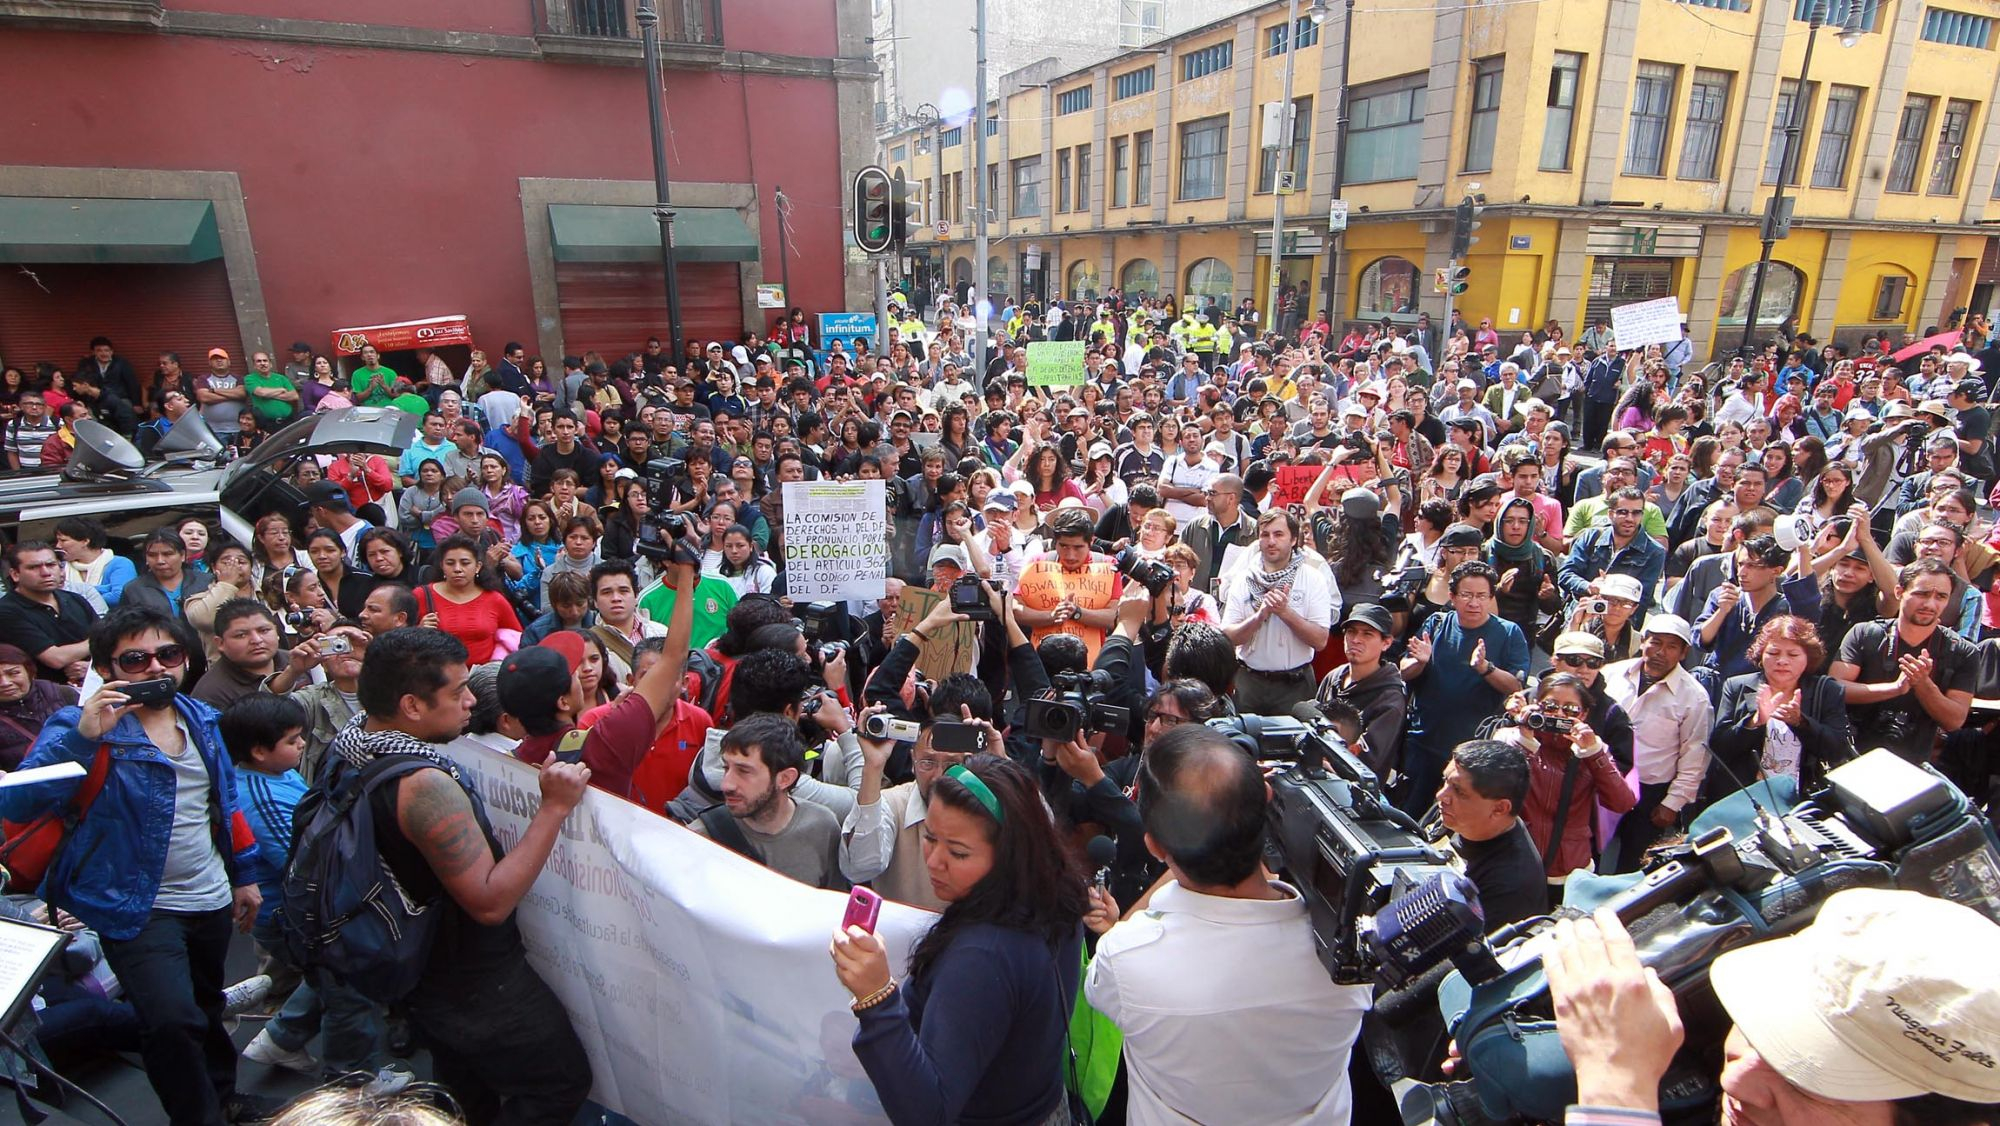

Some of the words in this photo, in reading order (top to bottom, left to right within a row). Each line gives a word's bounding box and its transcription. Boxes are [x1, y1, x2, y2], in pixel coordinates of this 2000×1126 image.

[786, 513, 801, 524] LA
[805, 513, 857, 524] COMISION
[861, 512, 876, 522] DE
[786, 524, 837, 536] DERECHOS
[855, 522, 869, 534] DEL
[786, 536, 801, 545] SE
[862, 534, 876, 544] POR
[785, 544, 884, 560] DEROGACION
[788, 561, 810, 571] DEL
[815, 560, 861, 571] ARTICULO
[864, 556, 887, 569] 362
[788, 573, 809, 583] DEL
[814, 572, 850, 583] CODIGO
[854, 570, 886, 581] PENAL
[790, 585, 811, 595] DEL
[820, 584, 840, 595] D.F.
[1885, 995, 1948, 1047] Niagara
[1947, 1040, 1998, 1069] Falls
[1902, 1030, 1953, 1063] Canada
